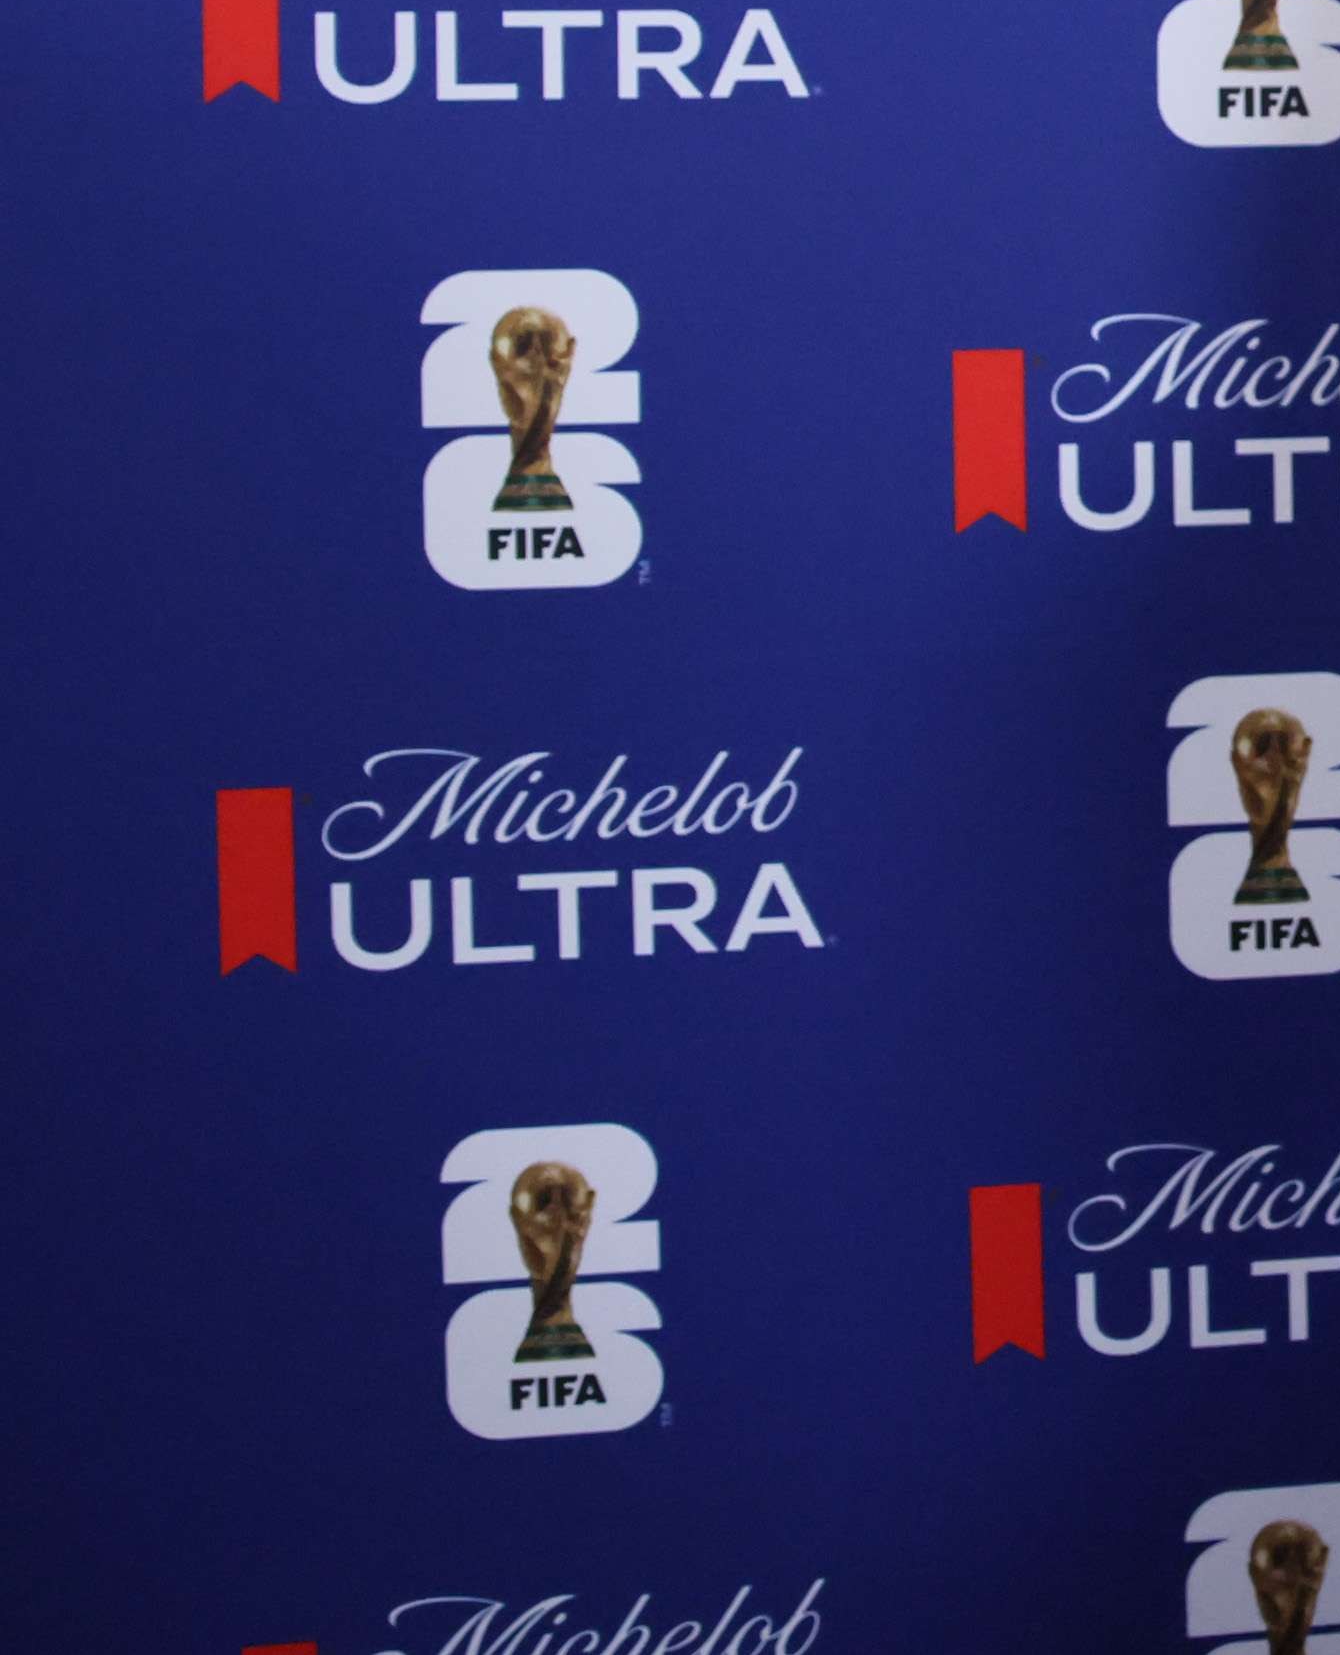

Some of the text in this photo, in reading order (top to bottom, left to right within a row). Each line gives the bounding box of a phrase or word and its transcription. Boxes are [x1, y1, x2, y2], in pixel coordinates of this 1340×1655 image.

[315, 9, 810, 104] ULTRA
[1219, 86, 1310, 118] FIFA
[488, 526, 585, 561] FIFA
[322, 747, 803, 860] Michelob
[331, 863, 824, 970] ULTRA
[1230, 917, 1321, 952] FIFA
[510, 1373, 607, 1410] FIFA
